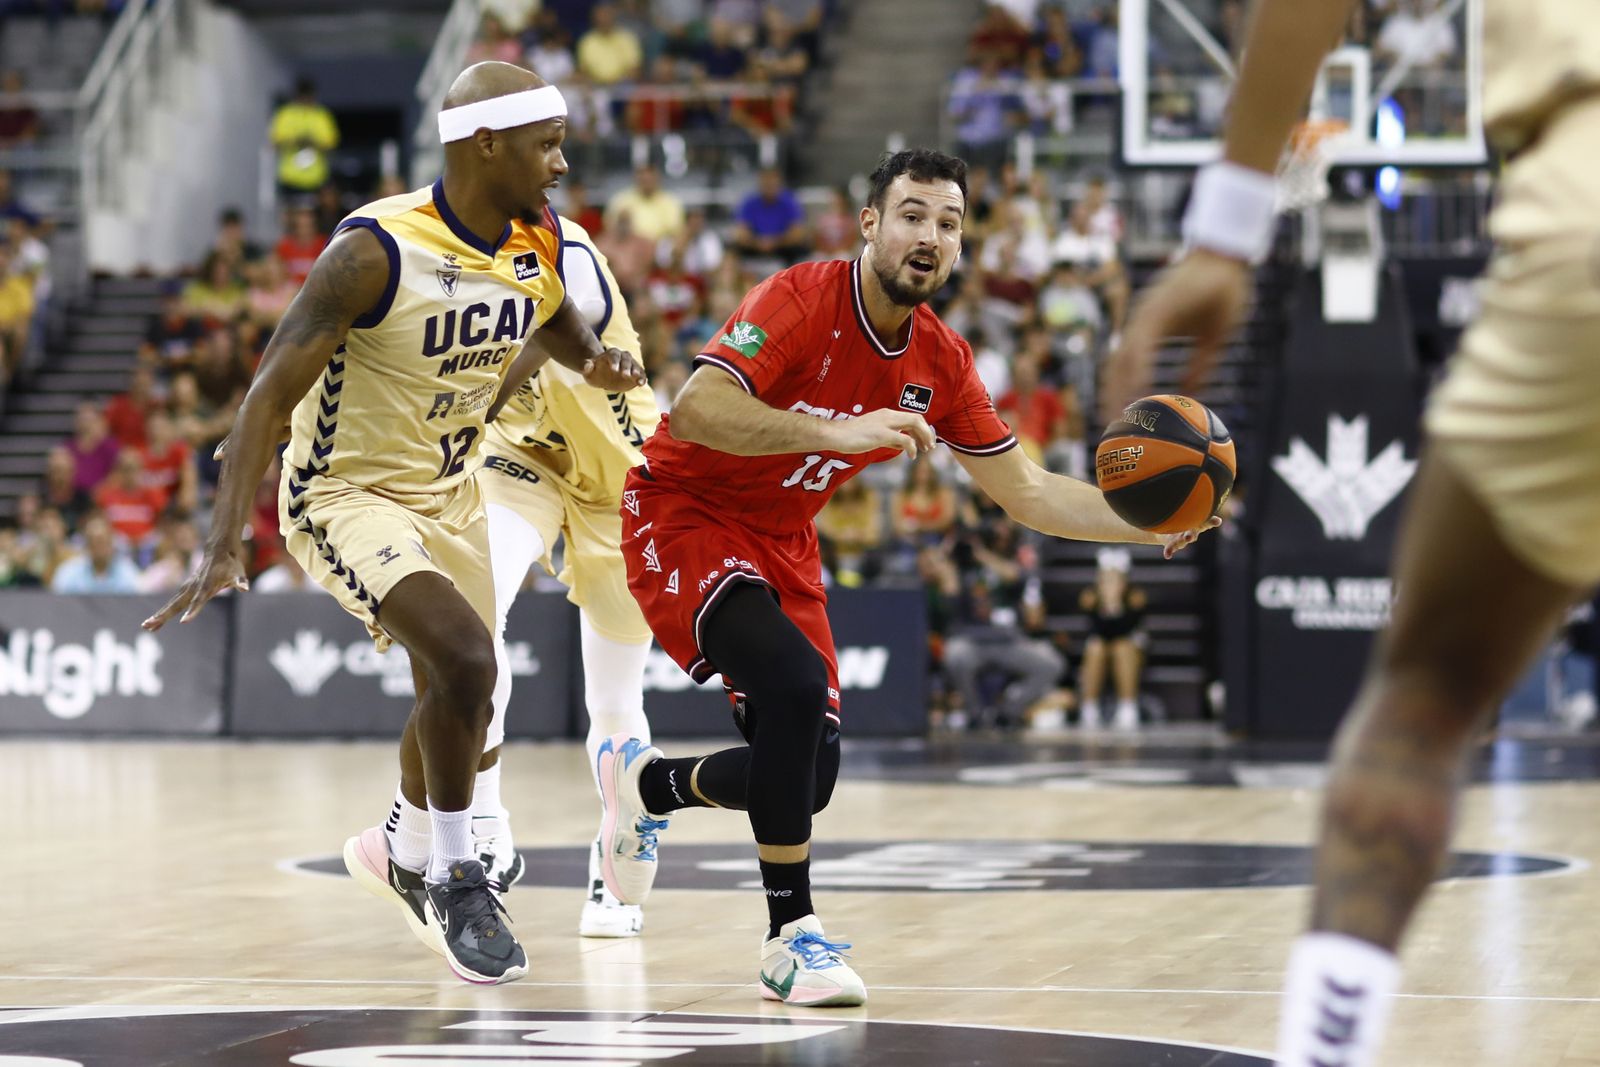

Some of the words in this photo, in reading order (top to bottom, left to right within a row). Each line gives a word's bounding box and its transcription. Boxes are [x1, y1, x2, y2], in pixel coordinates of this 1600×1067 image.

[902, 399, 927, 410] endesa
[432, 426, 479, 481] 12
[781, 455, 854, 492] 15
